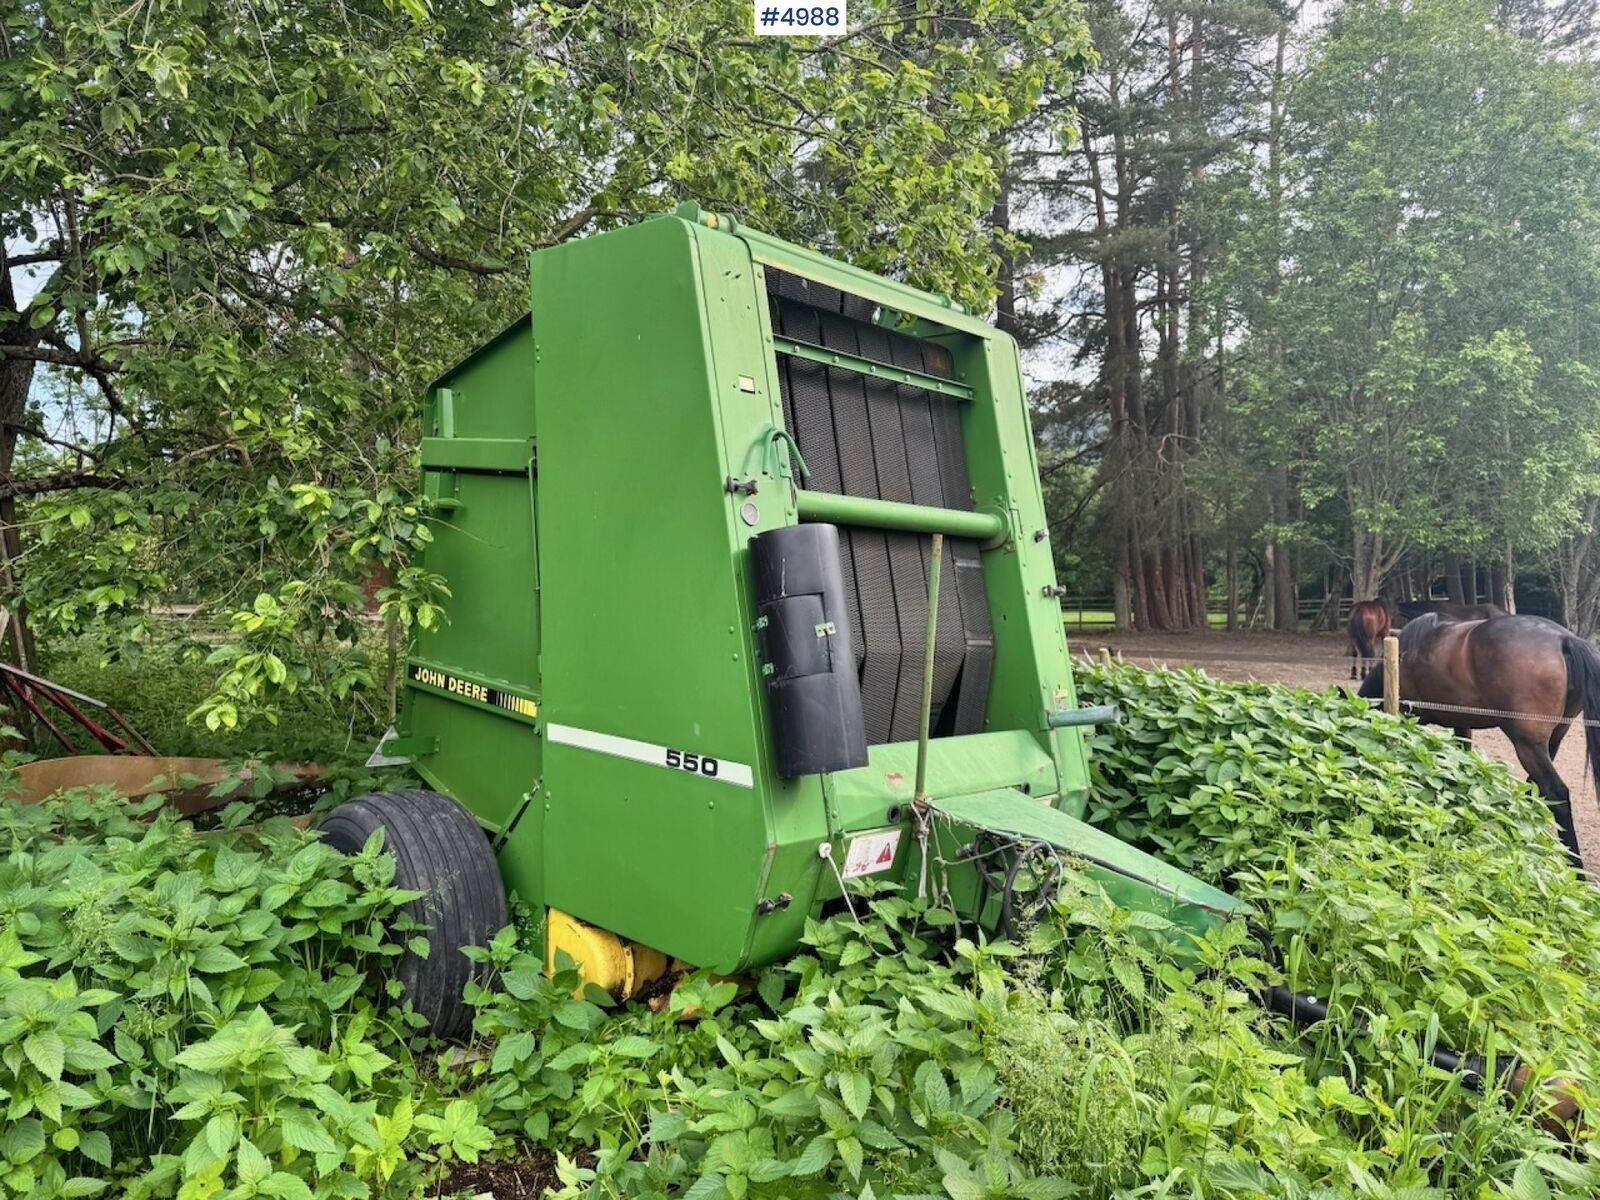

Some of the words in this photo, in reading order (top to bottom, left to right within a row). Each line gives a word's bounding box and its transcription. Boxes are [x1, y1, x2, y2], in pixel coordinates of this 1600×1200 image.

[415, 667, 445, 688] JOHN
[448, 677, 488, 702] DEERE
[666, 748, 718, 777] 550
